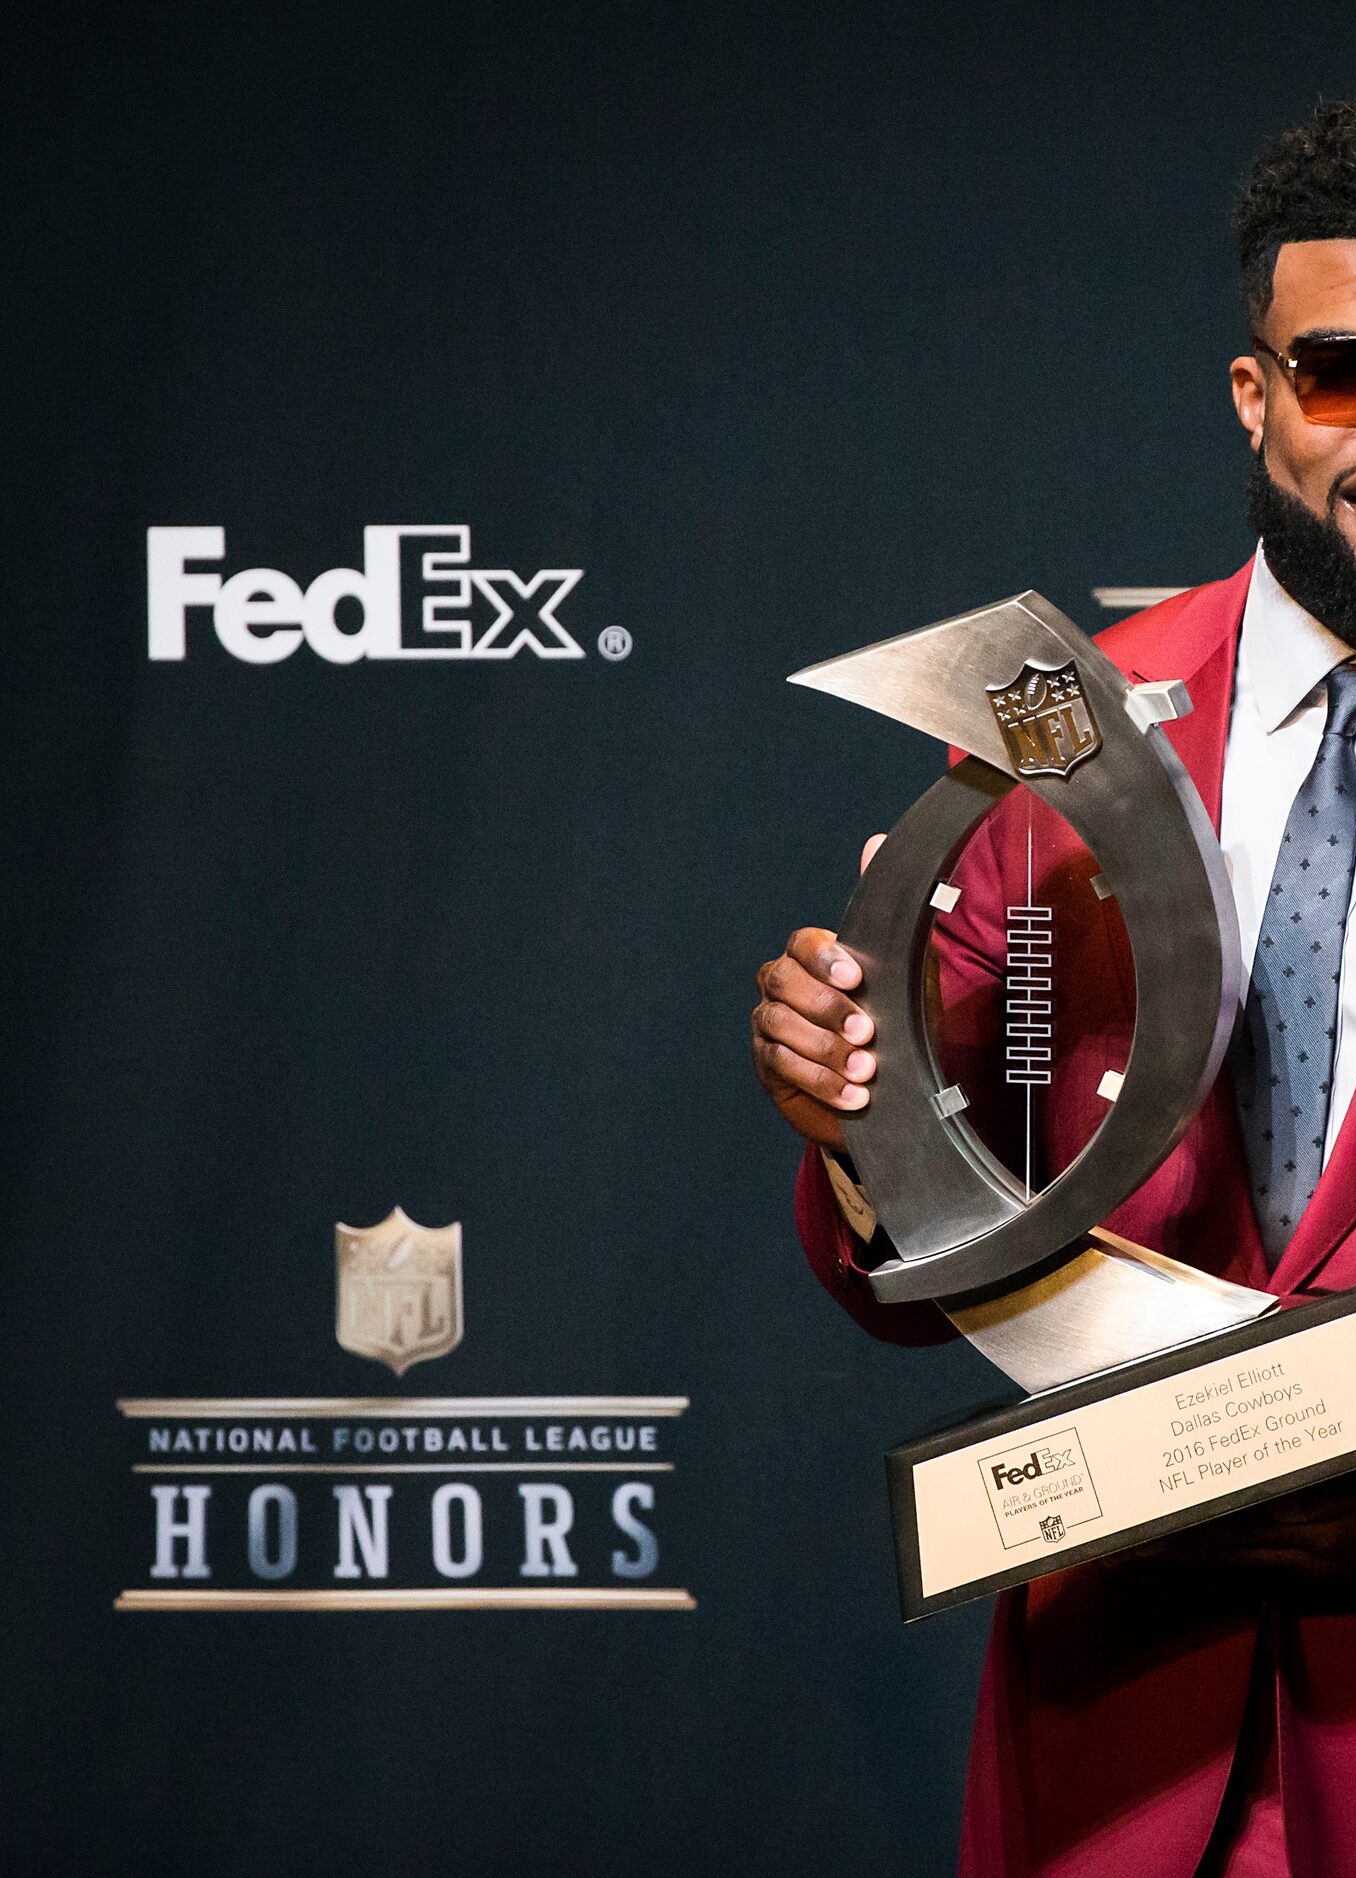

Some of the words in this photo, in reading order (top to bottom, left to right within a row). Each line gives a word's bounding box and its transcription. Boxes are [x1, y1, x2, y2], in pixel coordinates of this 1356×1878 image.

[147, 525, 586, 664] FedEx
[1007, 703, 1094, 767] NFL
[1170, 1411, 1221, 1437] Dallas
[1225, 1383, 1303, 1418] Cowboys
[1175, 1378, 1234, 1410] Ezekiel
[1237, 1363, 1286, 1389] Elliott
[149, 1427, 317, 1453] NATIONAL
[333, 1427, 508, 1452] FOOTBALL
[525, 1426, 657, 1452] LEAGUE
[1159, 1470, 1194, 1493] NFL
[1198, 1452, 1248, 1480] Player
[1253, 1444, 1270, 1461] of
[1274, 1435, 1302, 1455] the
[1304, 1421, 1344, 1442] Year
[1163, 1441, 1205, 1468] 2016
[1208, 1424, 1262, 1451] FedEx
[1265, 1399, 1327, 1432] Ground
[991, 1448, 1076, 1490] FedEx
[1003, 1495, 1021, 1509] AIR
[1022, 1492, 1031, 1502] &
[1033, 1475, 1082, 1498] GROUND
[1004, 1503, 1037, 1517] PLAYERS
[1039, 1498, 1049, 1506] OF
[1049, 1493, 1063, 1502] THE
[1065, 1487, 1084, 1497] YEAR
[150, 1482, 659, 1579] HONORS
[1044, 1526, 1064, 1541] NFL
